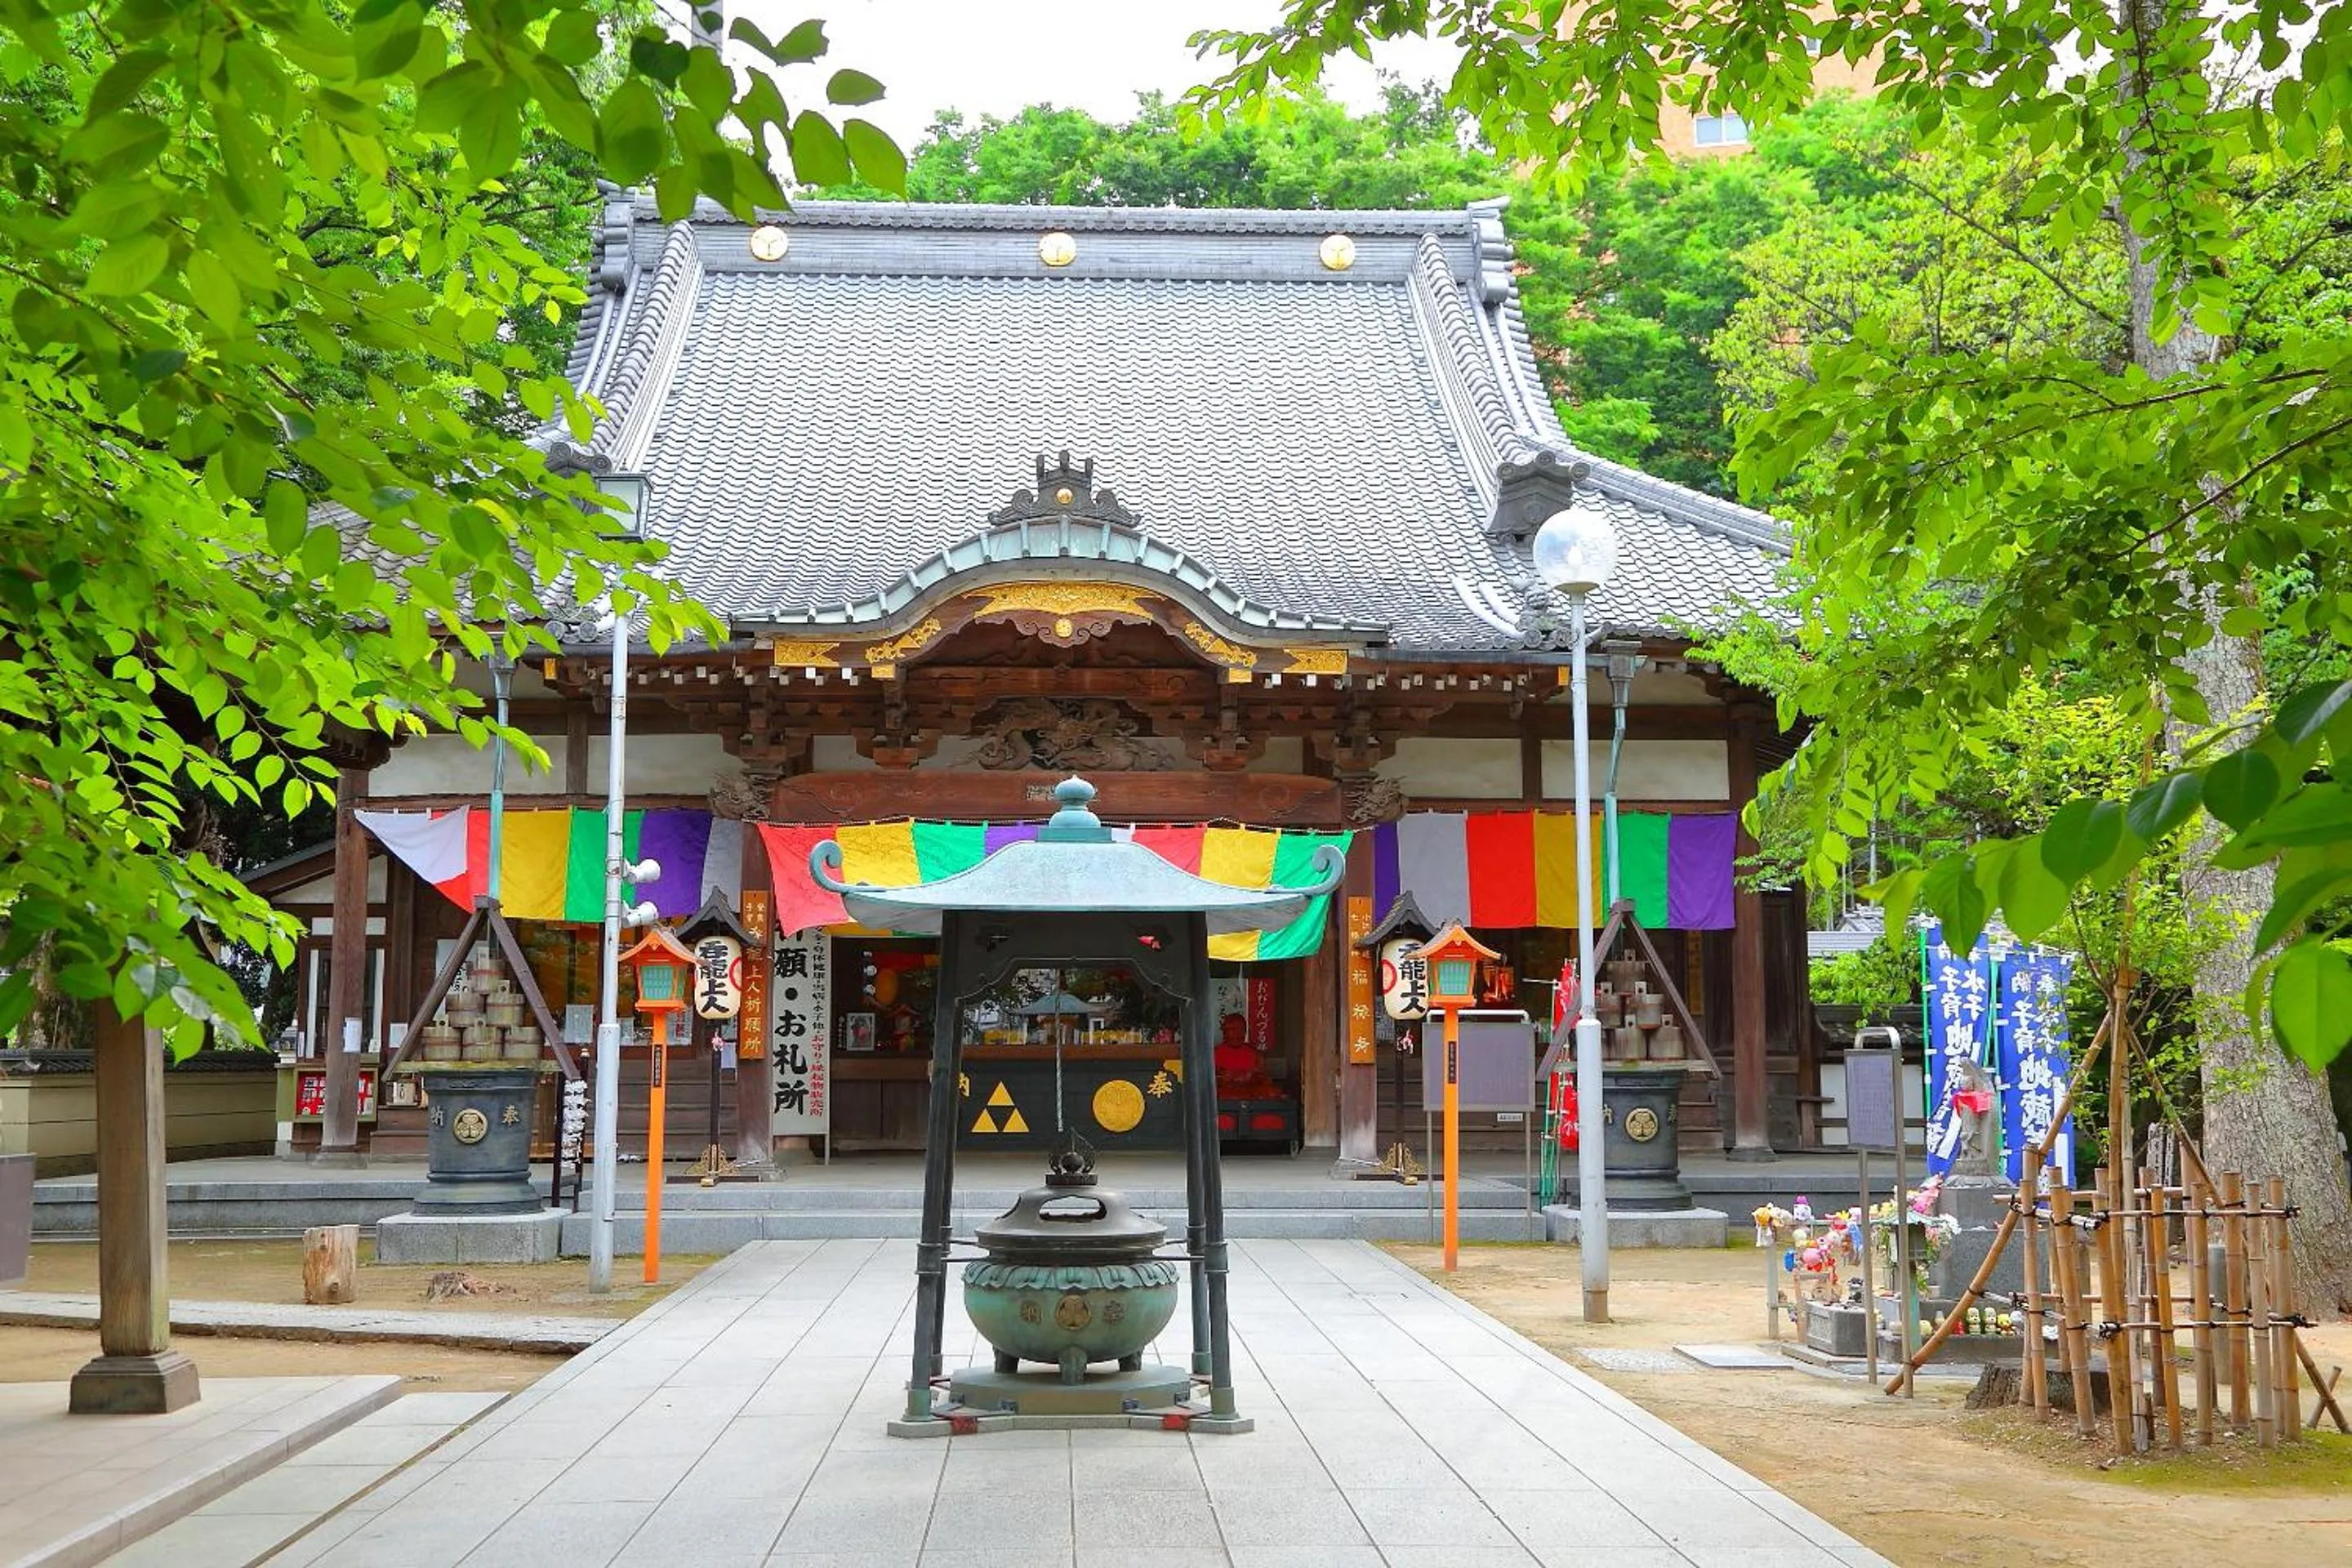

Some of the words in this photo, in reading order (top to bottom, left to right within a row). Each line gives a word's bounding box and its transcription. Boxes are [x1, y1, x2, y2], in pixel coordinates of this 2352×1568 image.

[1940, 965, 1962, 1019] 子育
[1962, 969, 1986, 1021] 水子
[774, 924, 809, 1116] 願・お札所
[2011, 999, 2036, 1054] 子育
[1147, 1071, 1173, 1098] 奉
[501, 1104, 519, 1127] 奉
